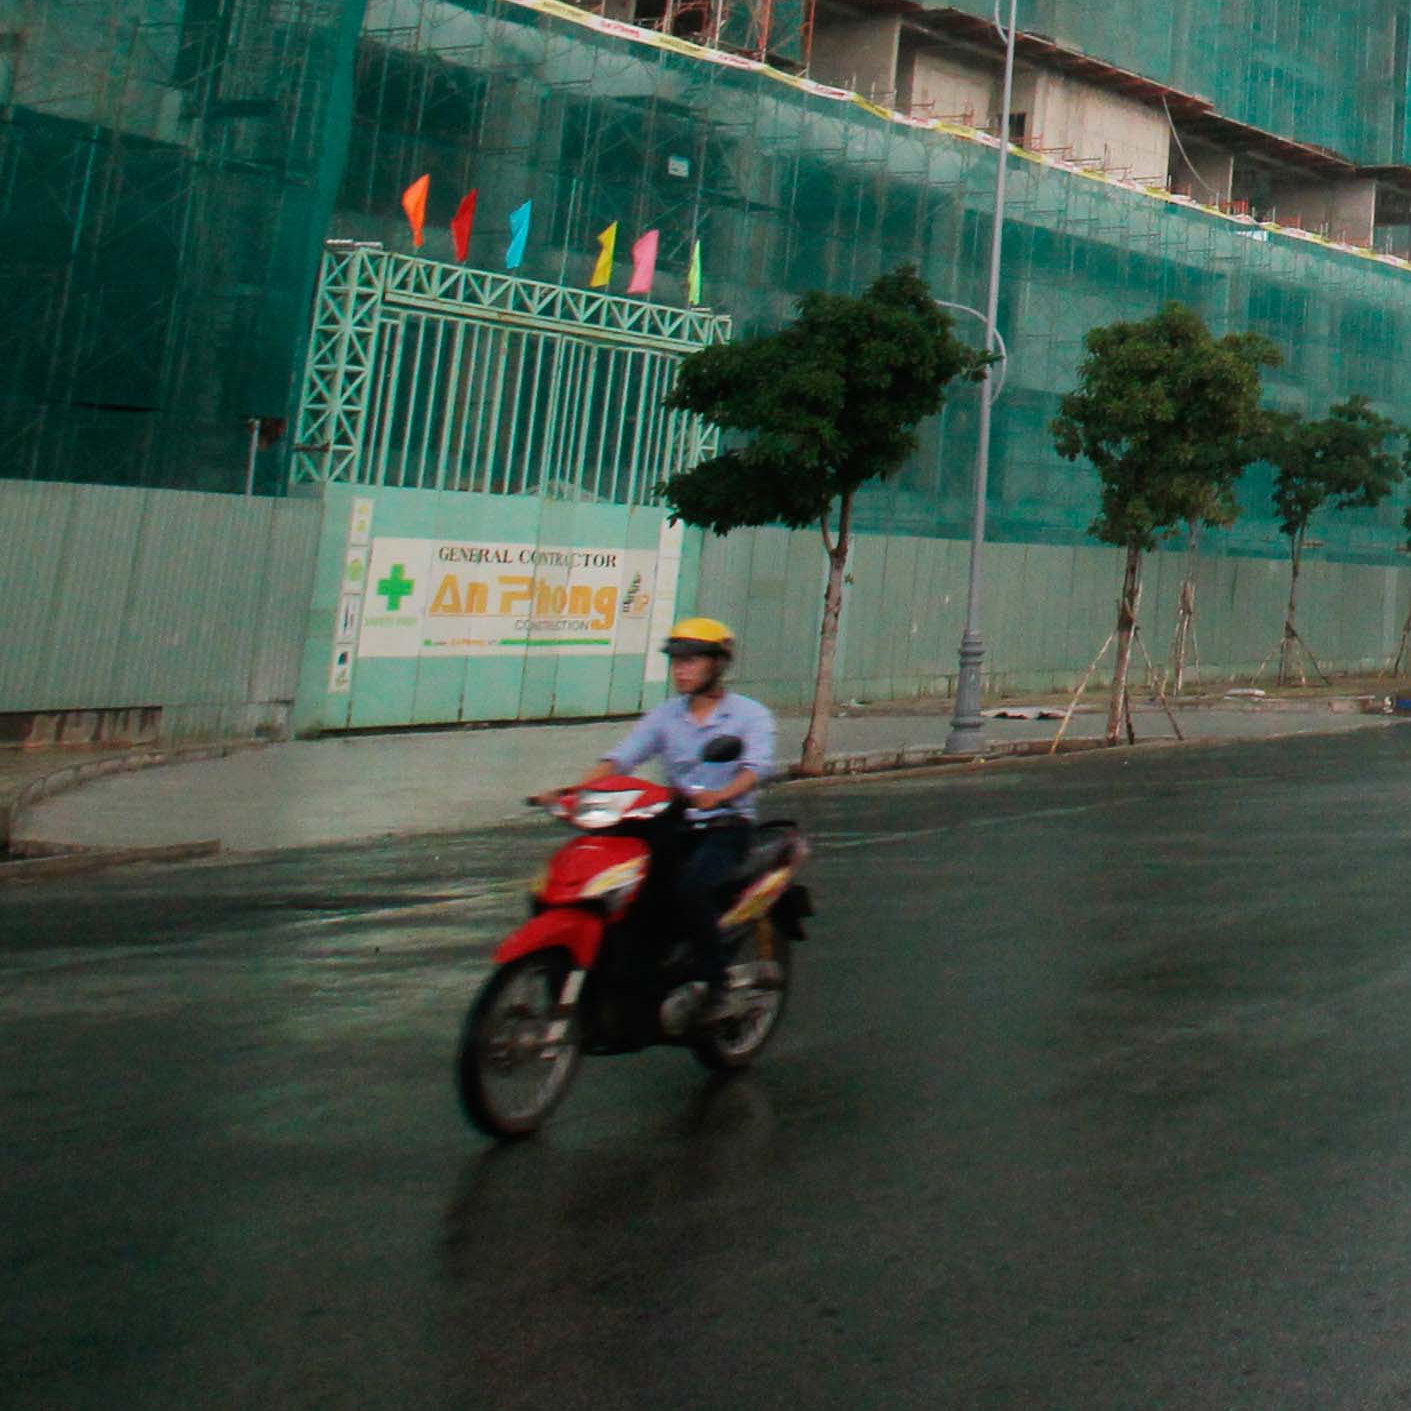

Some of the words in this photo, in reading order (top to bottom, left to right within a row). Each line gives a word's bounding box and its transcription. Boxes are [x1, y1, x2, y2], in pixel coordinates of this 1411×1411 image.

[438, 546, 513, 564] GENERAL
[429, 573, 490, 615] An
[497, 575, 619, 631] Phong
